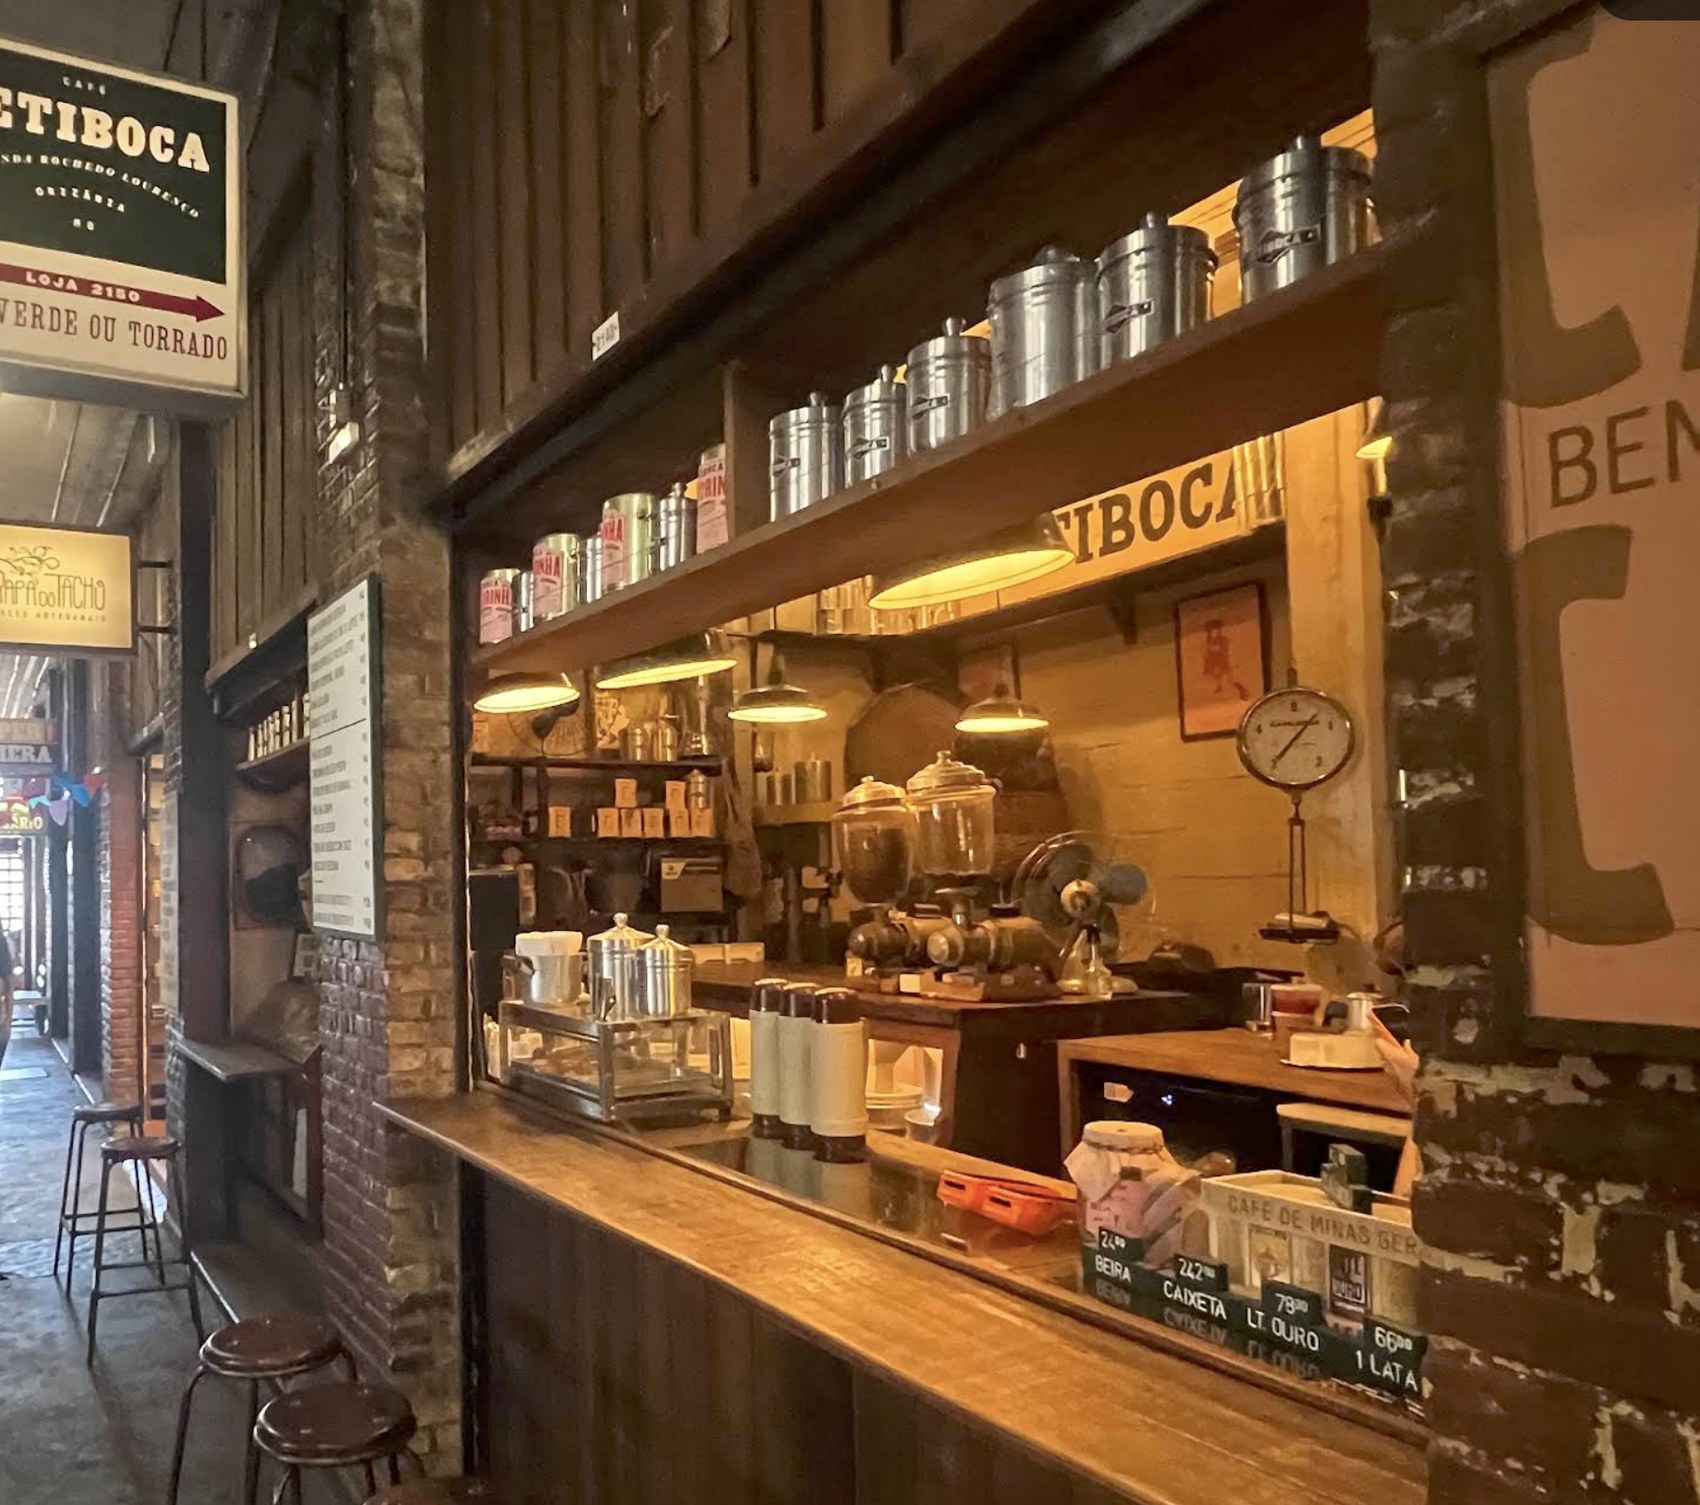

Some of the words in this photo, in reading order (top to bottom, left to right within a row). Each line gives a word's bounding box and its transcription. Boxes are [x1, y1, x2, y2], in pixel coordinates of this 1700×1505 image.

[40, 154, 116, 177] ROCHEDO
[121, 172, 200, 218] LOURENÇO
[26, 271, 78, 292] LOJA
[90, 314, 116, 342] OU
[128, 320, 228, 360] TORRADO
[44, 572, 105, 611] TACHO
[1279, 1206, 1303, 1230] DE
[1309, 1215, 1369, 1245] MINAS
[1095, 1254, 1131, 1283] BEIRA
[1163, 1280, 1227, 1320] CAIXETA
[1271, 1317, 1319, 1353] OURO
[1355, 1350, 1363, 1370] 1
[1369, 1353, 1418, 1392] LATA
